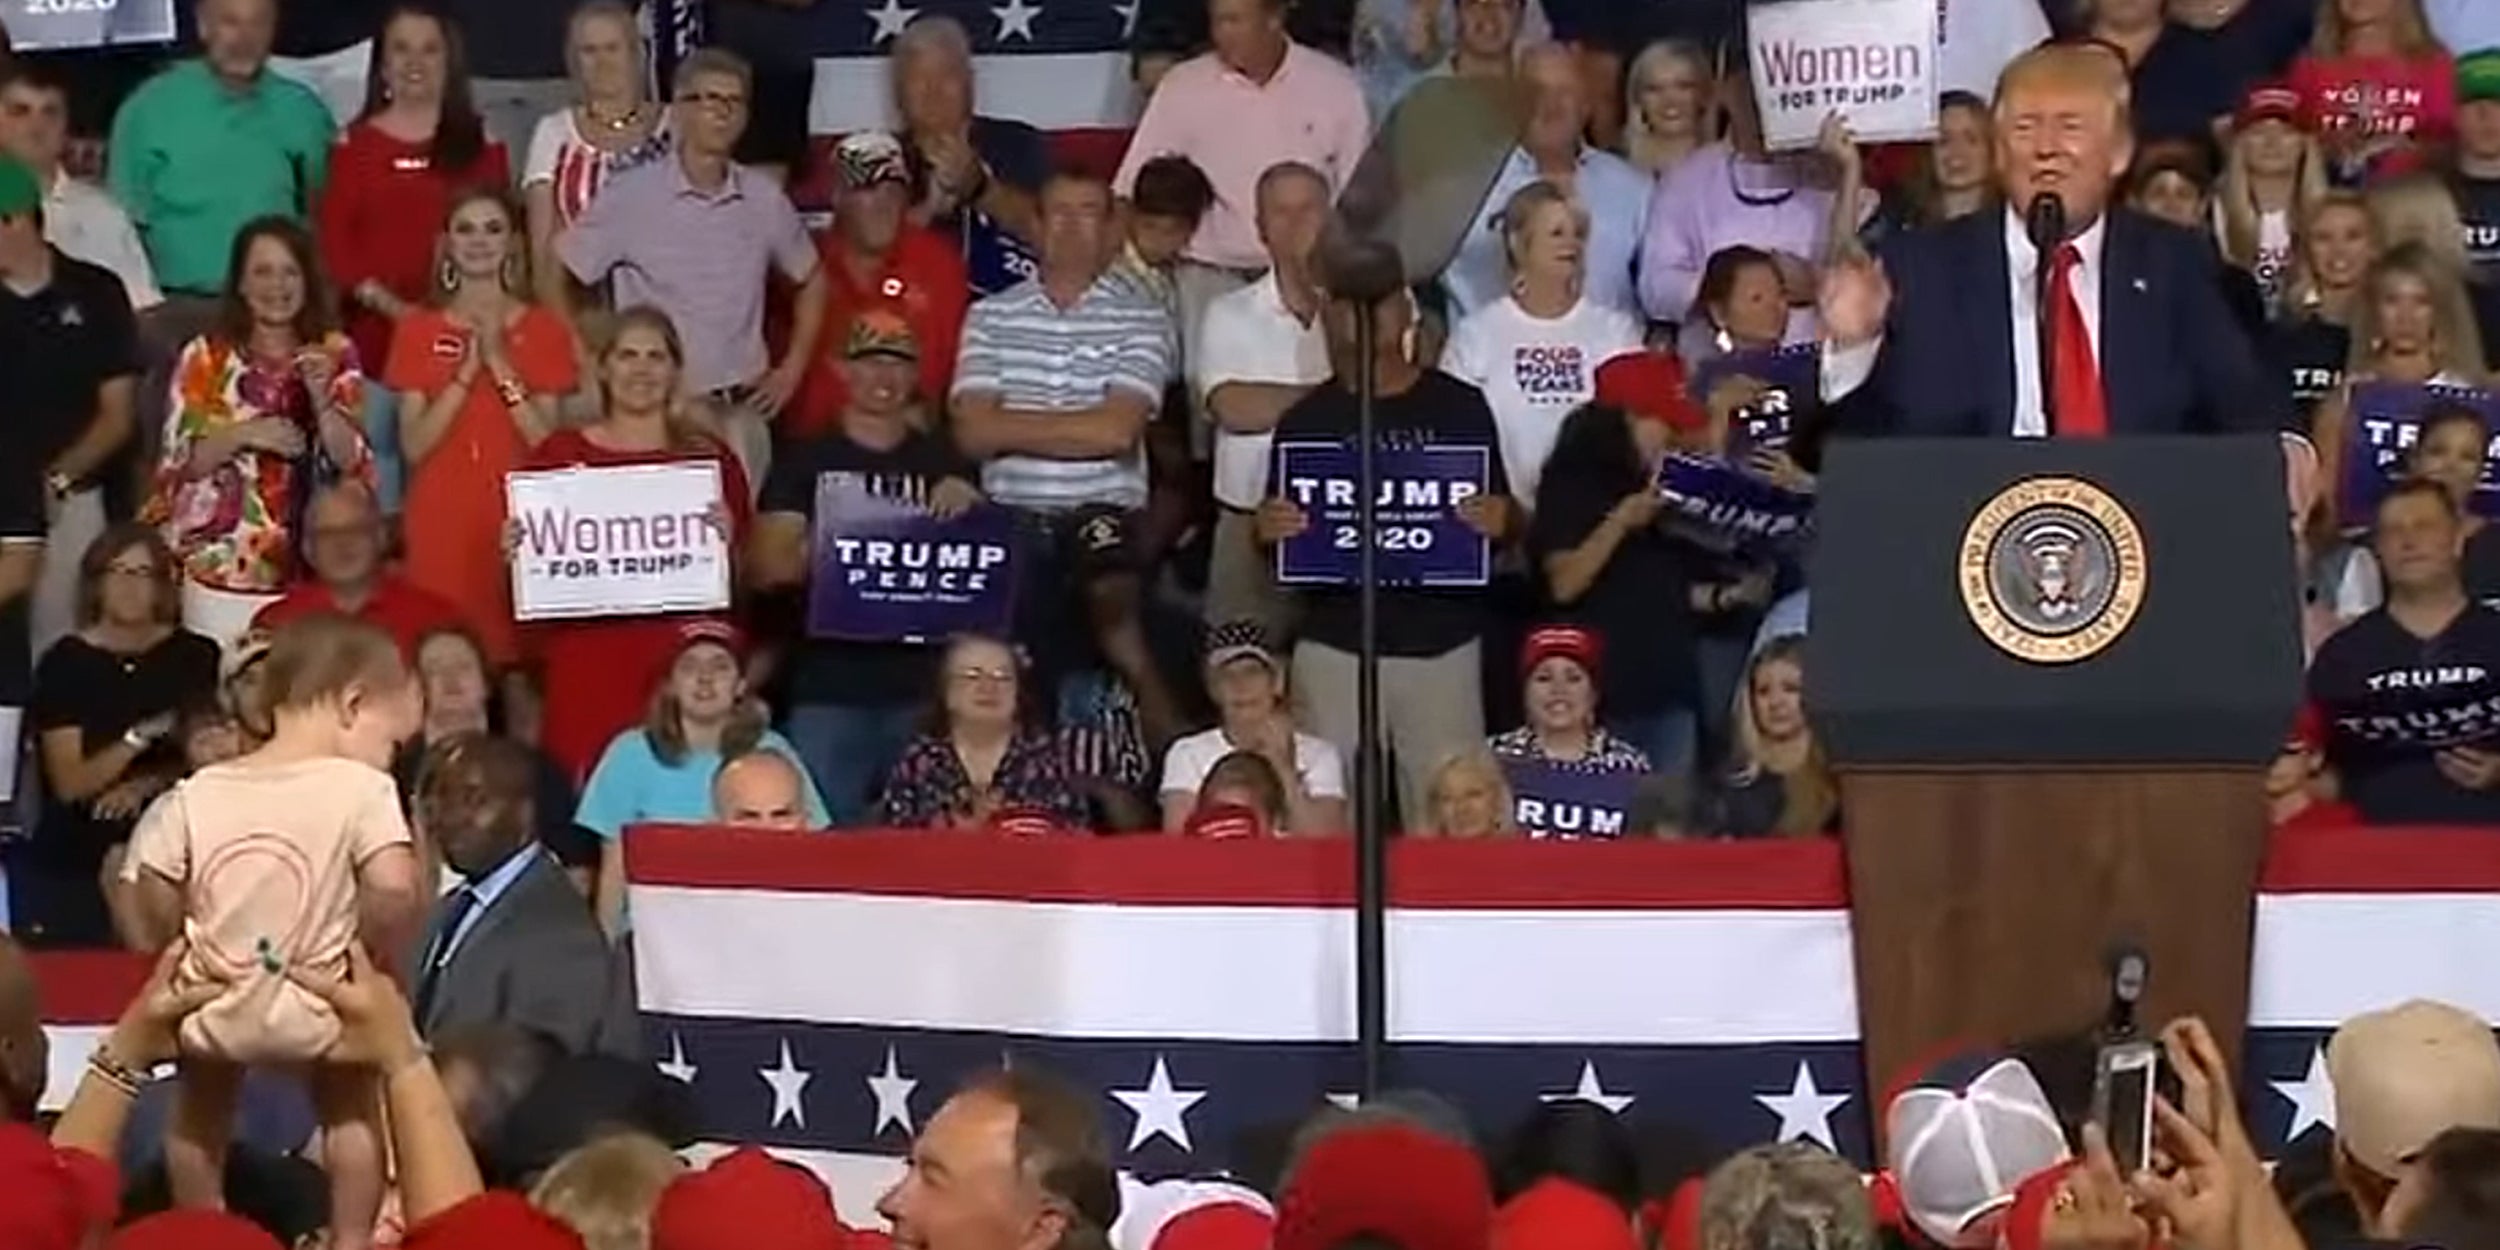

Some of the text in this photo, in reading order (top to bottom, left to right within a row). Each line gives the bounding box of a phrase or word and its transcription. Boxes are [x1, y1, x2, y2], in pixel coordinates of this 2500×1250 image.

[1760, 40, 1920, 87] Women
[1779, 83, 1905, 111] FOR TRUMP
[2323, 88, 2421, 106] WOEN
[1002, 251, 1039, 280] 20
[525, 506, 709, 556] Women
[1333, 525, 1433, 550] 220
[550, 553, 693, 579] FOR TRUMP
[835, 537, 1006, 569] TRUMP
[848, 568, 988, 590] PENCE
[2366, 666, 2488, 690] TRUMP
[1516, 798, 1624, 835] RUM
